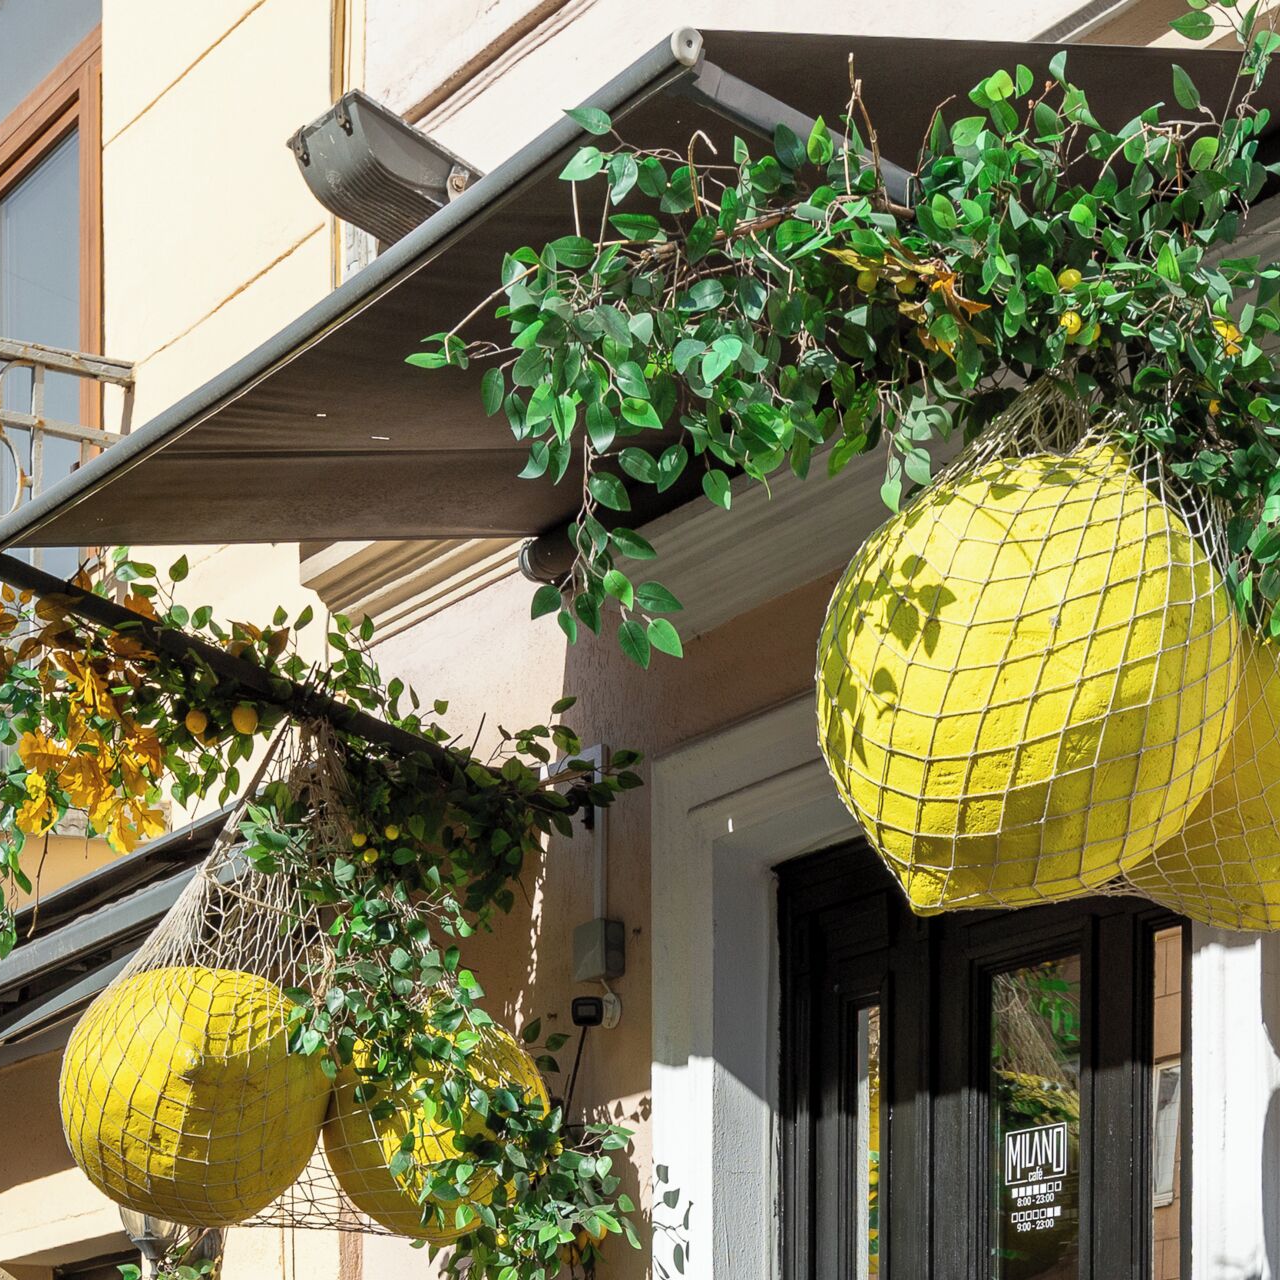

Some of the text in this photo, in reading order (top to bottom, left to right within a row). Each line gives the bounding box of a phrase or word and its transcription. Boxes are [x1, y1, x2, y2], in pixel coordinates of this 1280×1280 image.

[1008, 1127, 1064, 1181] MILANO
[1028, 1166, 1043, 1182] café
[1017, 1196, 1031, 1207] 8:00
[1036, 1193, 1054, 1205] 23:00
[1017, 1222, 1031, 1232] 9:00
[1036, 1218, 1054, 1230] 23:00
